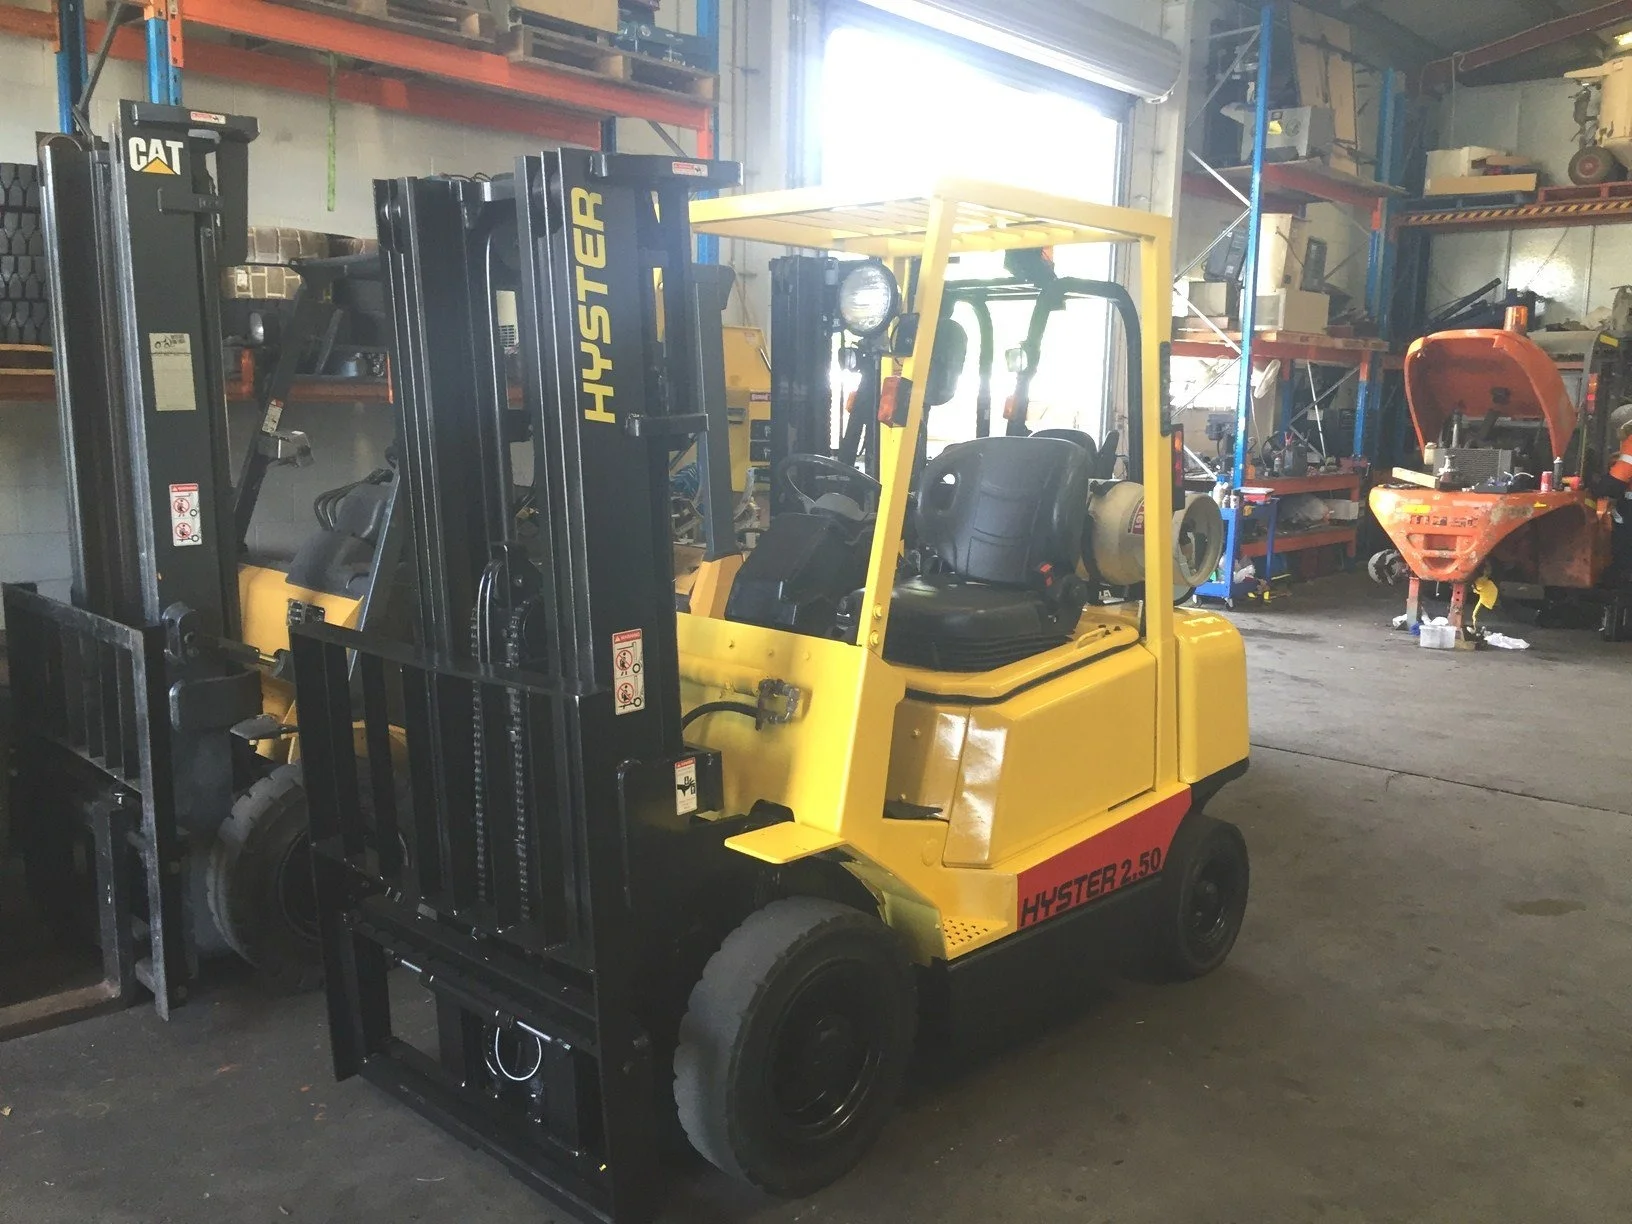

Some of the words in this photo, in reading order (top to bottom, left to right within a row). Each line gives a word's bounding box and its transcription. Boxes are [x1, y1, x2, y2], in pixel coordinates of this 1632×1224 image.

[128, 136, 184, 176] CAT
[570, 186, 616, 424] HYSTER
[1020, 863, 1117, 927] HYSTER
[1120, 847, 1162, 886] 2.50
